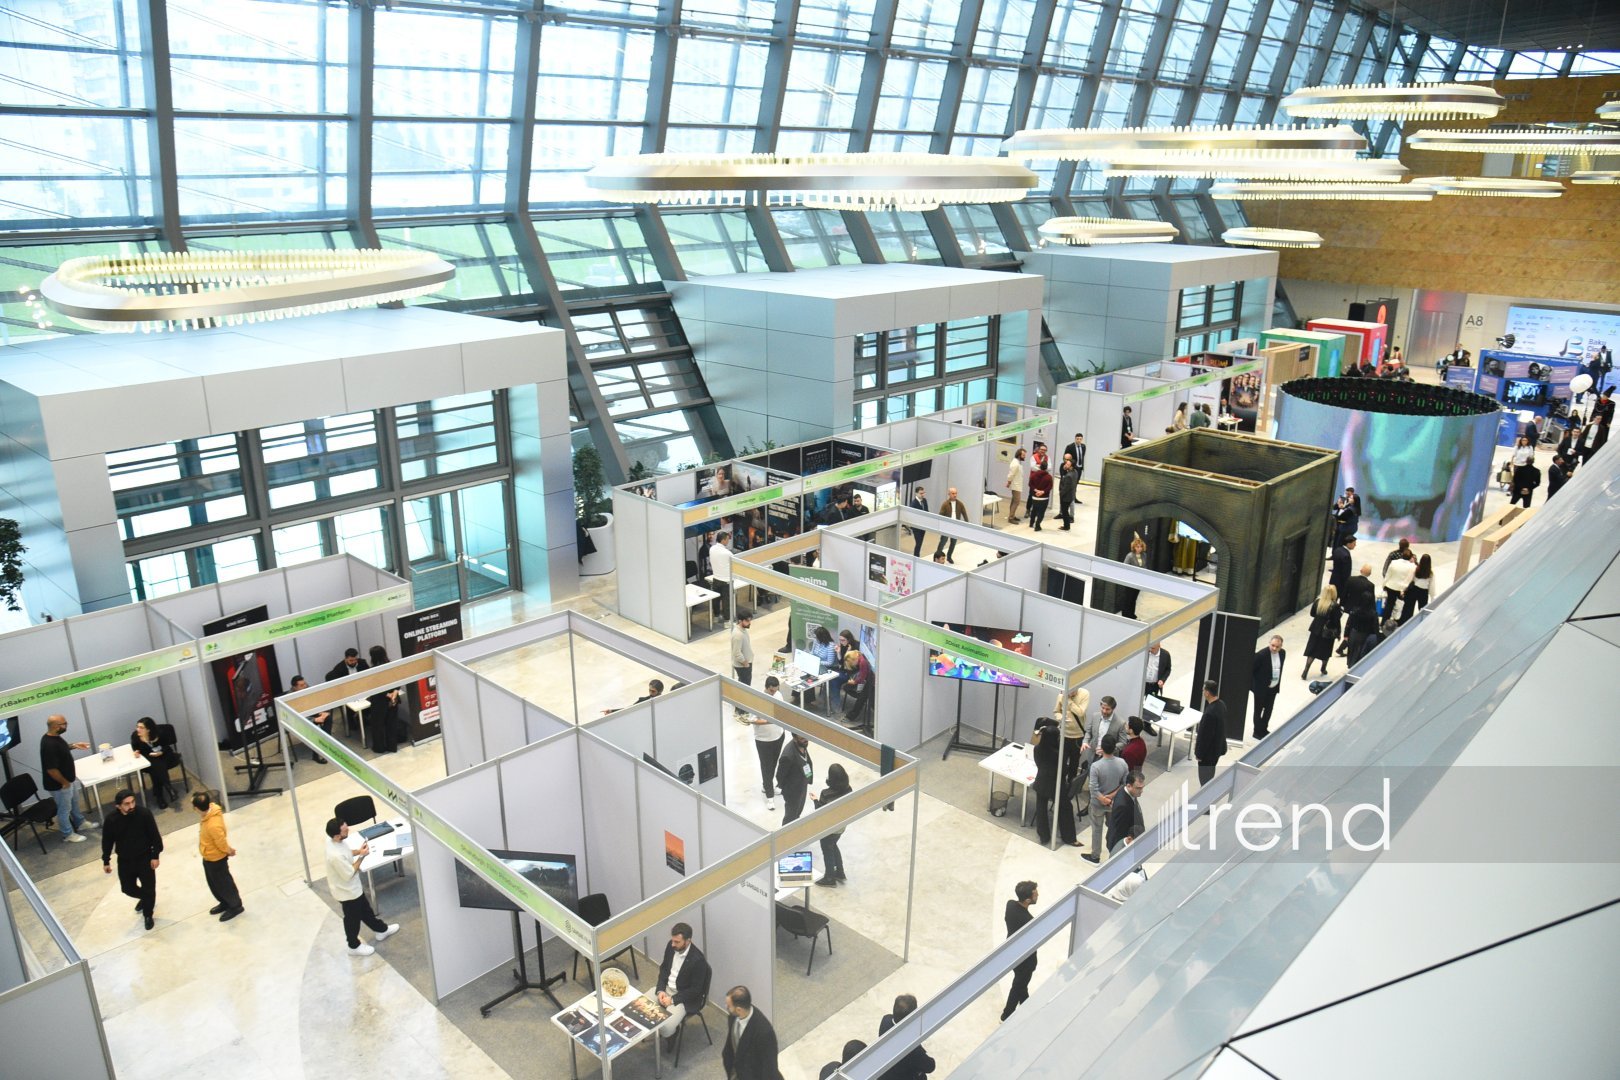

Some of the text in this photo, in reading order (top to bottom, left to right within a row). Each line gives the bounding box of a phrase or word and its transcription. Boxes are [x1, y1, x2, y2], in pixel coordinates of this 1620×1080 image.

[1465, 315, 1484, 326] A8
[800, 576, 828, 587] anima
[268, 607, 352, 635] Kinobox Streaming Platform
[403, 619, 458, 639] ONLINE STREAMING
[417, 629, 447, 642] PLATFORM
[960, 644, 989, 659] Animation
[1044, 672, 1065, 686] 3Dost
[0, 665, 142, 709] rtBakers Creative Advertising Agency
